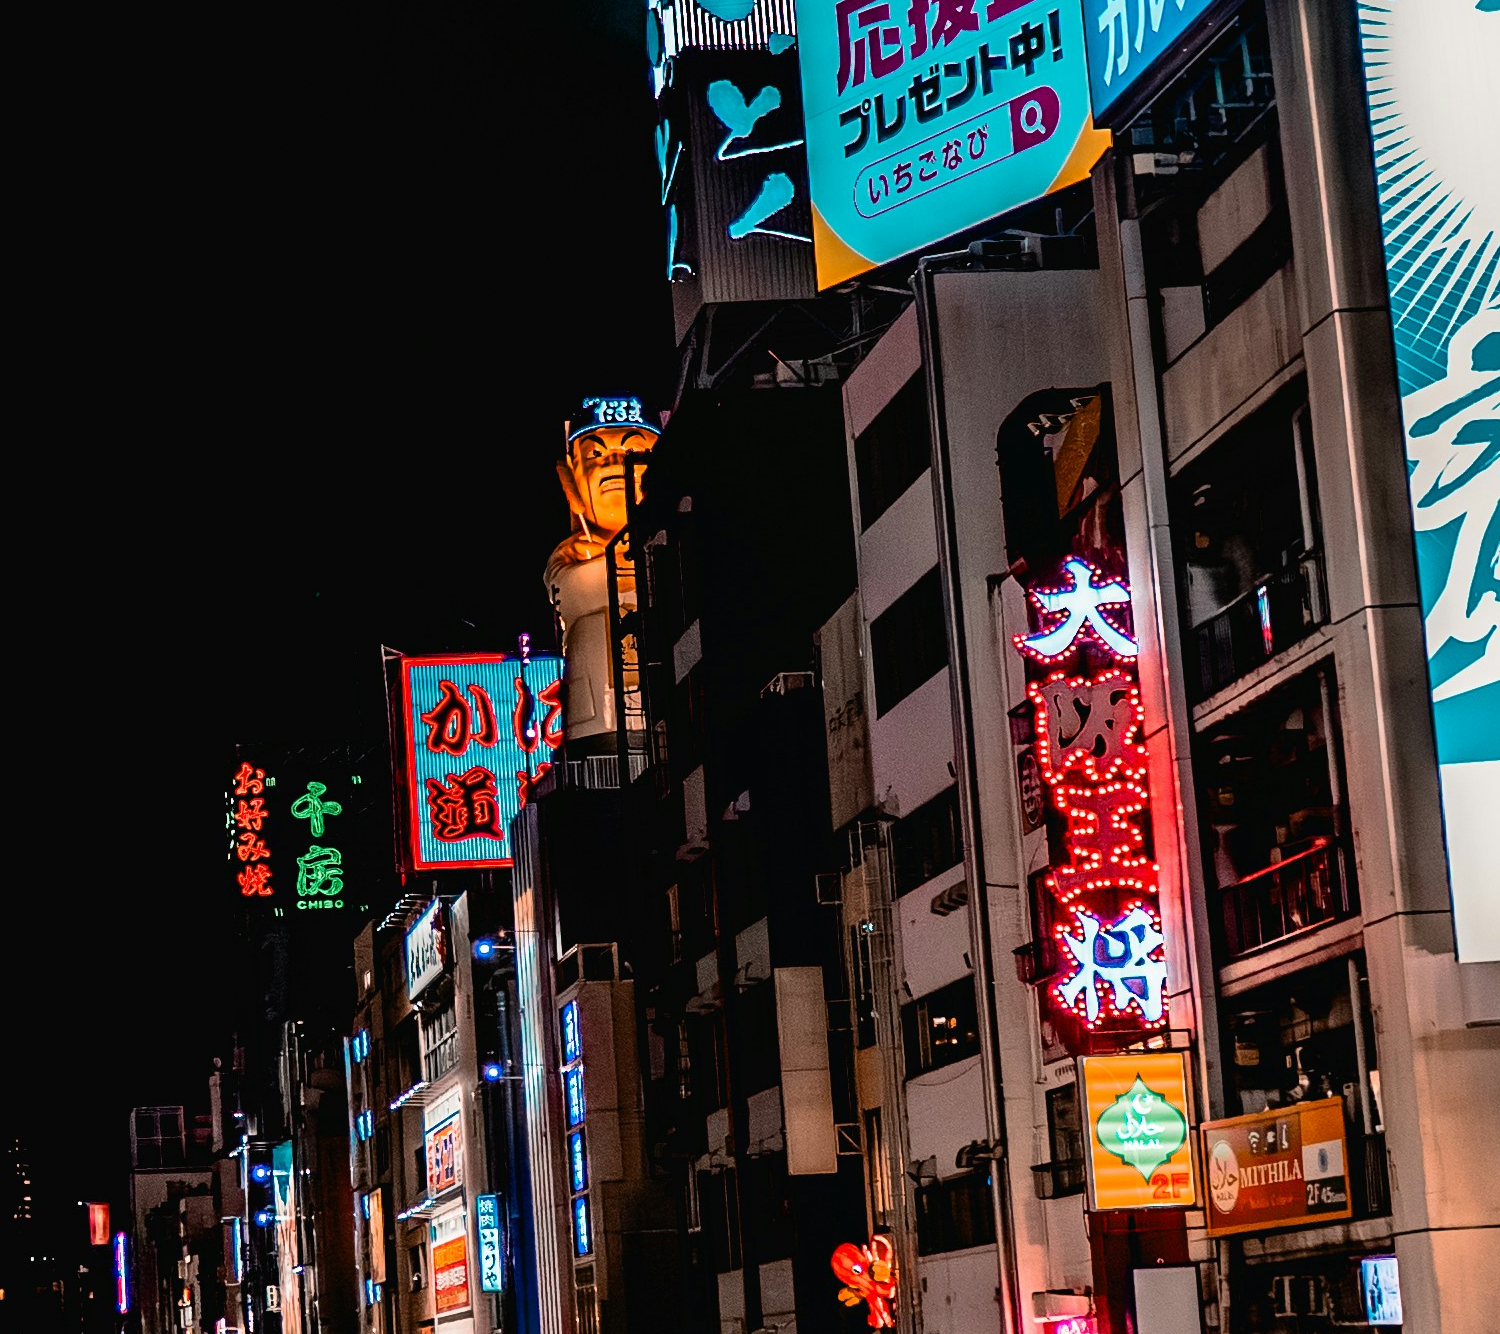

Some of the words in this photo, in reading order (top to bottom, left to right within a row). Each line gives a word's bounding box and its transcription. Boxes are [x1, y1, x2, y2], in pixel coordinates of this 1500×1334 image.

[838, 8, 1065, 158] プレゼント中!
[866, 123, 990, 206] いちごなび
[234, 762, 275, 898] お好み焼
[290, 780, 344, 897] 千房
[296, 899, 345, 910] CHIBO
[1150, 1172, 1191, 1200] 2F
[1239, 1158, 1304, 1190] MITHILA
